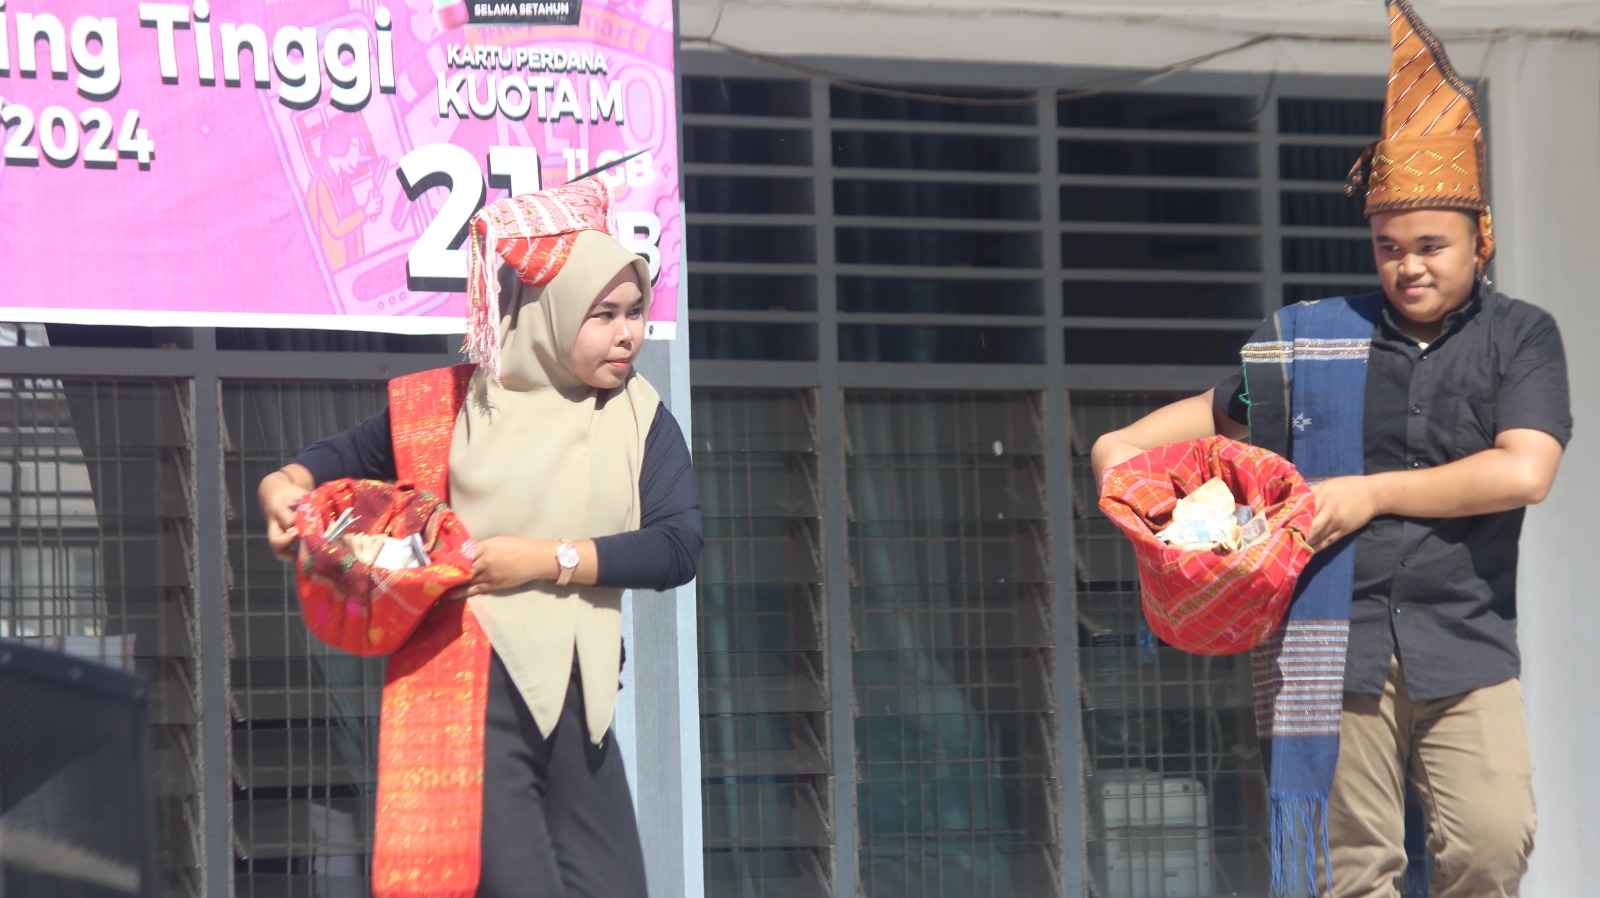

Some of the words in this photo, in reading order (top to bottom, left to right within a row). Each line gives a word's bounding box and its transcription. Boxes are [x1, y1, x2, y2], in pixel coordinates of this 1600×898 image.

[474, 3, 518, 17] SELAMA
[519, 2, 569, 16] SETAHUN
[138, 0, 397, 112] Tinggi
[446, 43, 512, 70] KARTU
[516, 47, 608, 75] PERDANA
[436, 71, 583, 124] KUOTA
[589, 78, 624, 126] M
